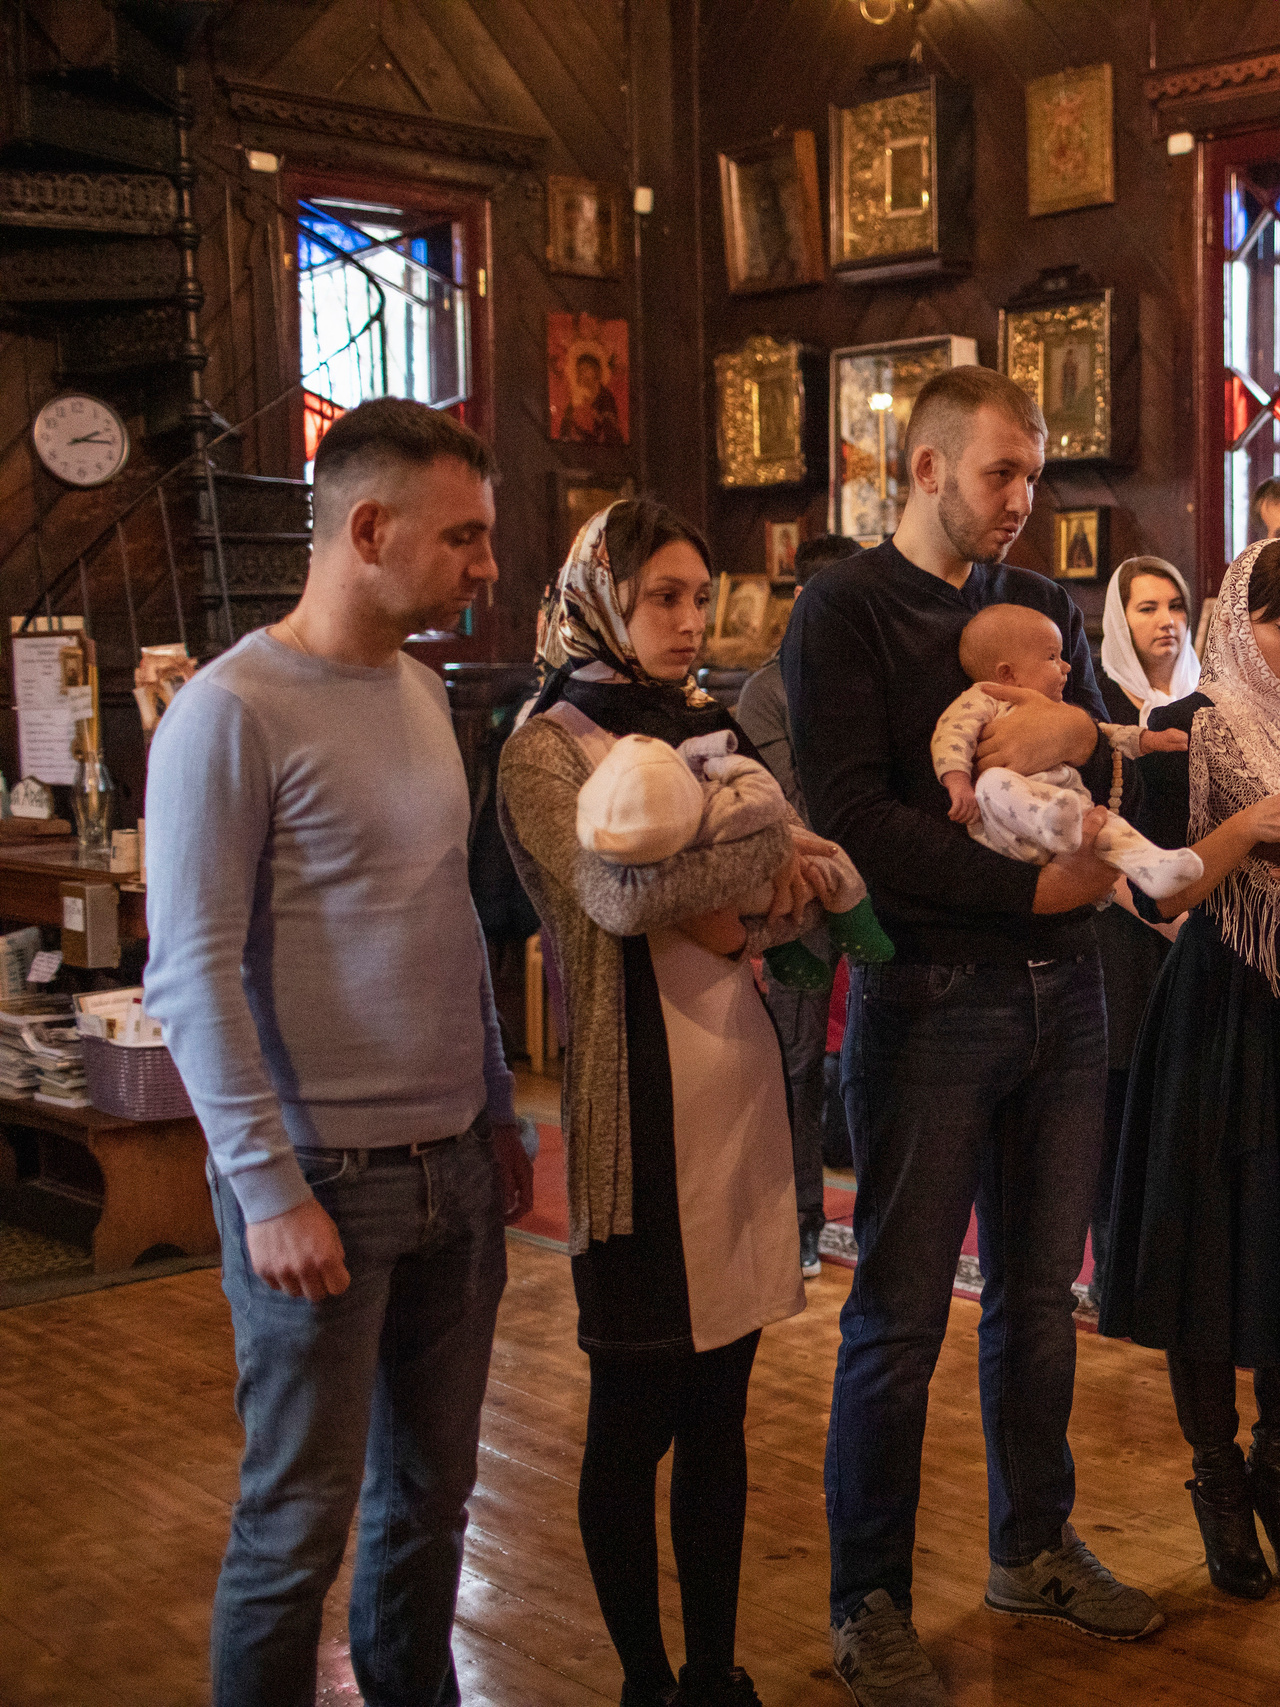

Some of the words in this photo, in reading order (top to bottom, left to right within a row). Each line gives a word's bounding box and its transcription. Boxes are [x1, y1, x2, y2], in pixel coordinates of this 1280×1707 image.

[55, 406, 66, 418] 11
[71, 401, 84, 414] 12
[44, 417, 58, 429] 10
[103, 418, 111, 432] 2
[1040, 1576, 1078, 1607] N
